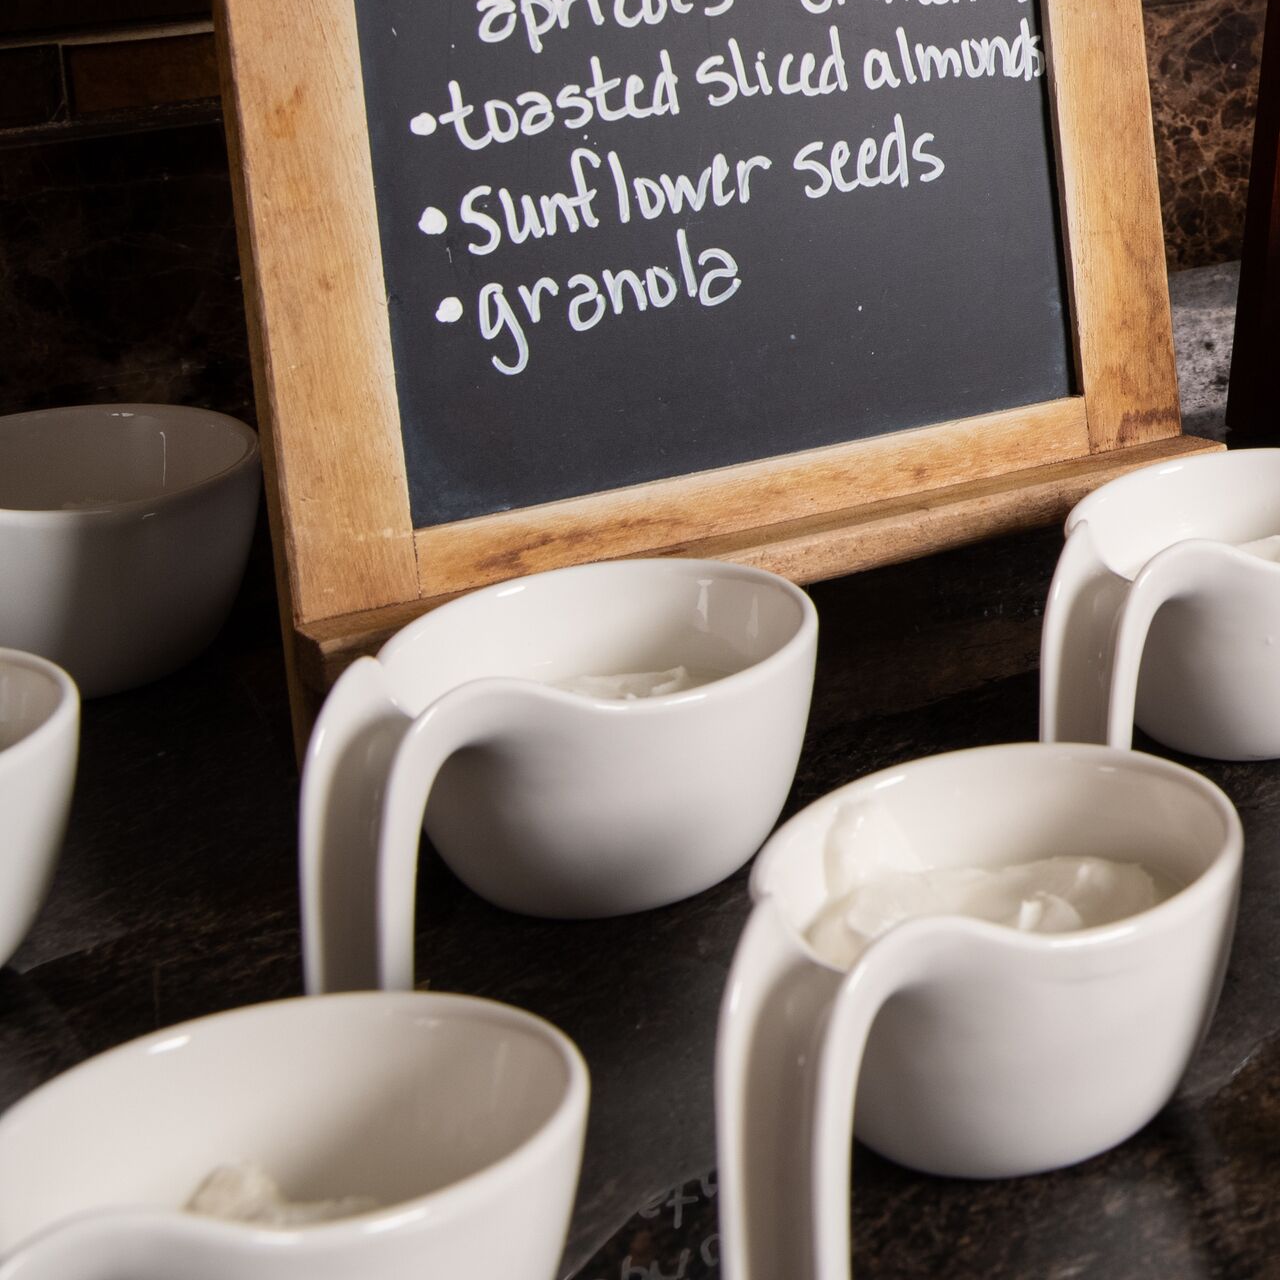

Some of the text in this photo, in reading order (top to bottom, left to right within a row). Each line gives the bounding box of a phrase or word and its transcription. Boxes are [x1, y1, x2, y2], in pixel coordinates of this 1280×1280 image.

[438, 16, 1045, 151] toasted sliced almonds
[792, 112, 946, 199] seeds
[478, 228, 742, 376] granola
